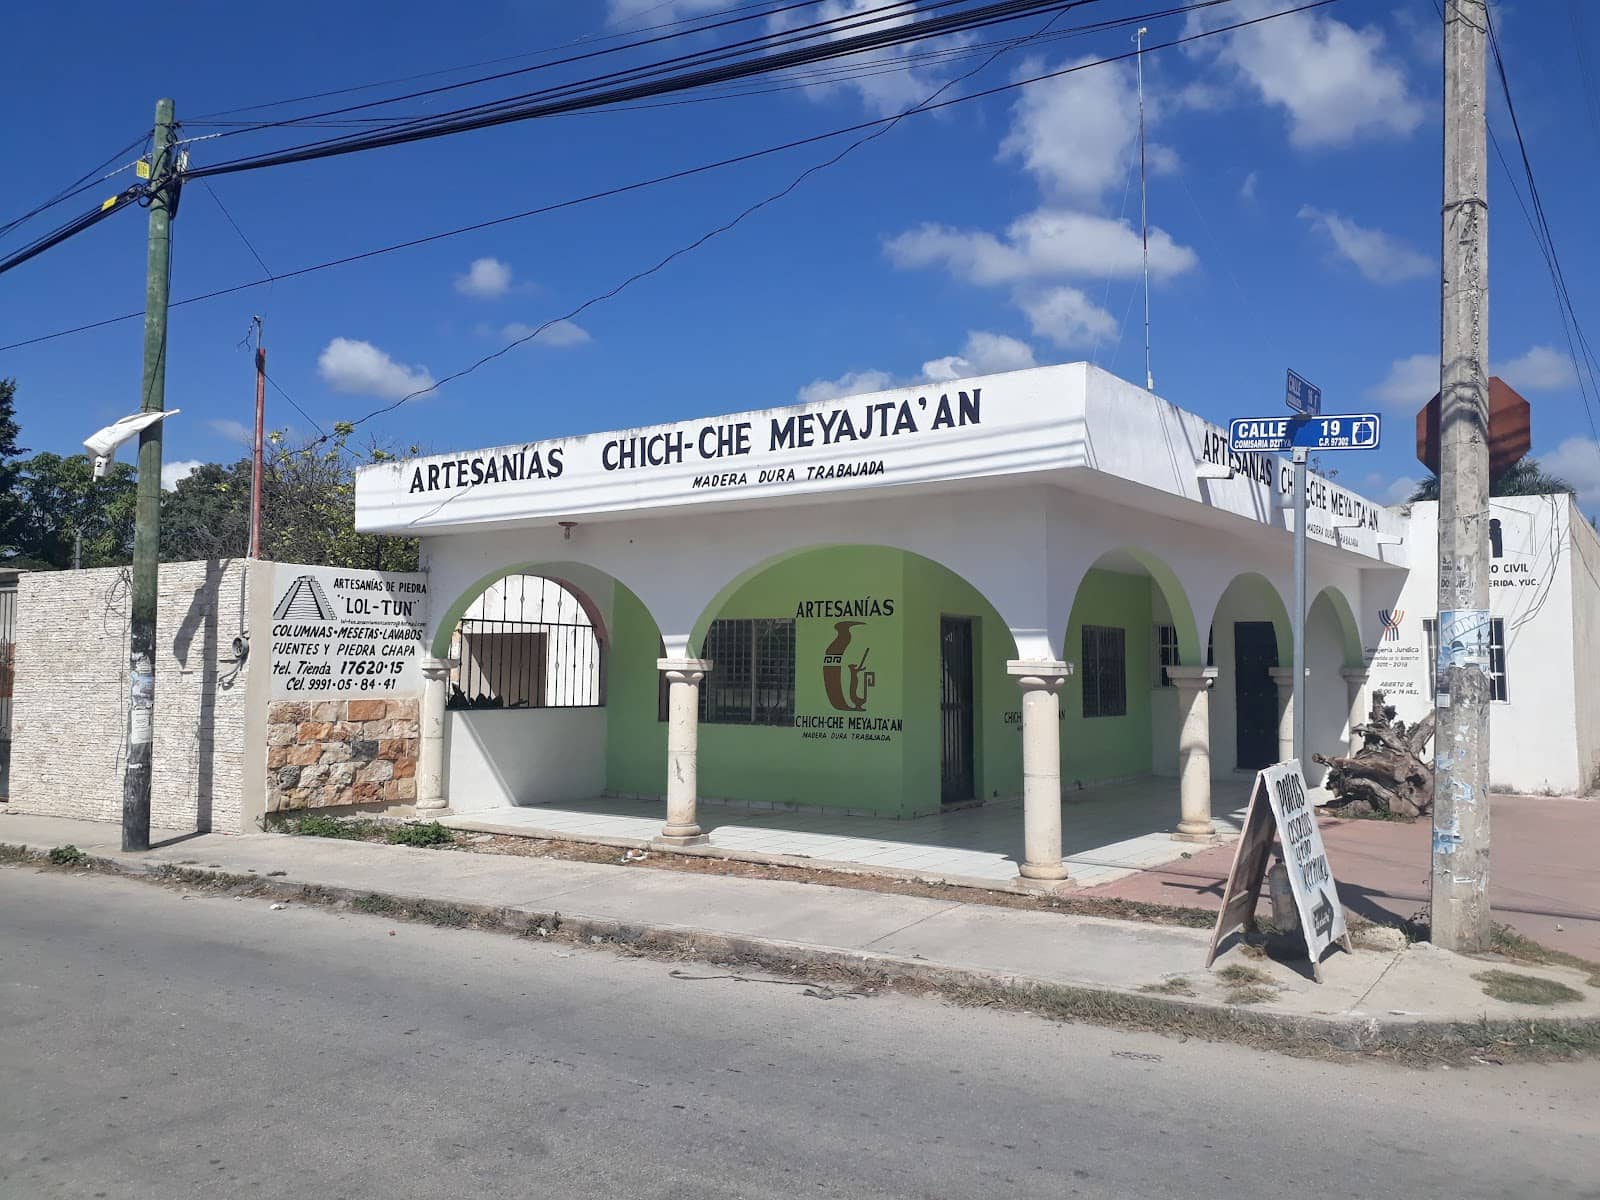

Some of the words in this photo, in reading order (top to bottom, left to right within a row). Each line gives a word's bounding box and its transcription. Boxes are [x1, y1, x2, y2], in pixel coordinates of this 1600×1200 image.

[1239, 422, 1288, 438] CALLE
[1320, 420, 1340, 436] 19
[409, 442, 563, 494] ARTESANÍAS
[602, 422, 751, 471] CHICH-CHE
[769, 389, 983, 452] MEYAJTA'AN
[1234, 439, 1268, 449] COMISARIA
[691, 471, 748, 489] MADERA
[758, 467, 796, 484] DURA
[806, 460, 885, 481] TRABAJADA
[1503, 563, 1528, 573] CIVIL
[333, 578, 383, 592] ARTESANÍAS
[386, 581, 395, 592] DE
[399, 582, 427, 594] PIEDRA
[1519, 578, 1540, 586] YUC.
[796, 596, 895, 618] ARTESANÍAS
[272, 643, 319, 655] FUENTES
[324, 644, 330, 655] Y
[337, 644, 376, 656] PIEDRA
[382, 644, 415, 656] CHAPA
[273, 660, 291, 675] tel.
[297, 661, 331, 675] Tienda
[286, 677, 305, 690] Cel.
[795, 715, 845, 729] CHICH-CHE
[801, 732, 827, 740] MADERA
[831, 732, 848, 740] DURA
[851, 733, 891, 742] TRABAJADA
